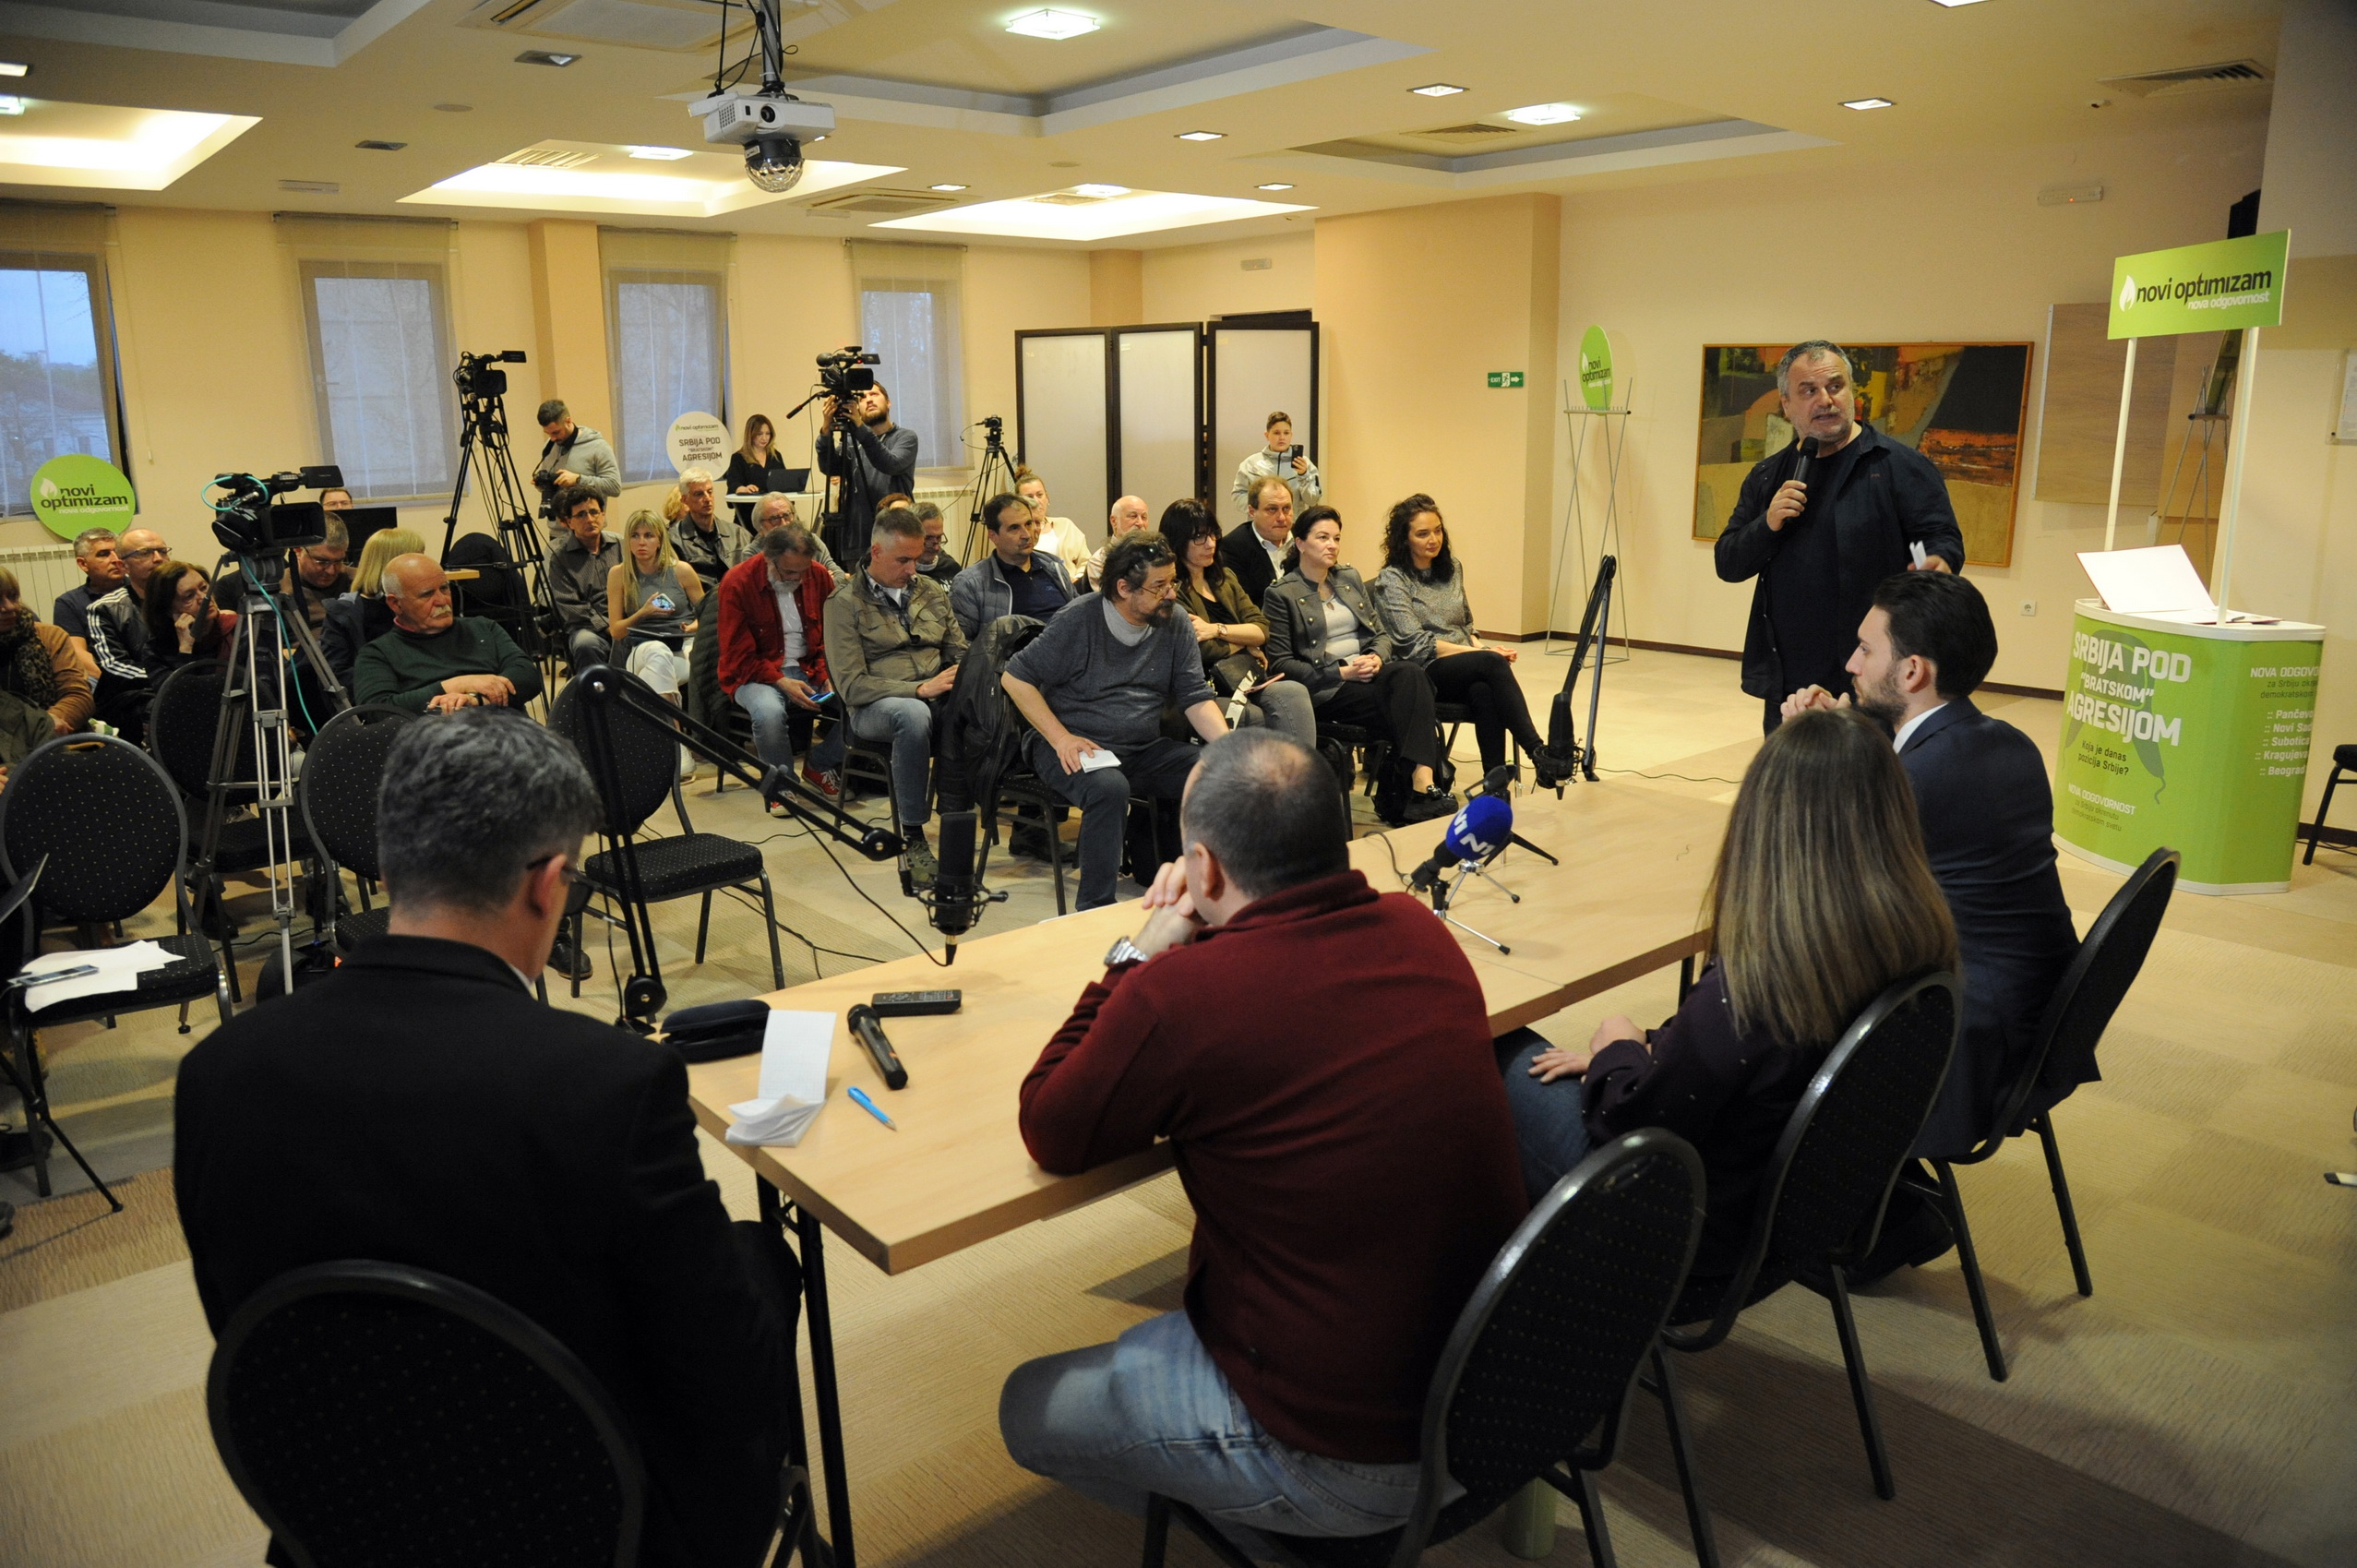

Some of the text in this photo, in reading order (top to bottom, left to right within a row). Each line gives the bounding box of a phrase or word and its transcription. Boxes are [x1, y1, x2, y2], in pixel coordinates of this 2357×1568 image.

[2136, 270, 2272, 305] novi optimizam
[2188, 290, 2270, 310] nova odgovornost
[1587, 355, 1601, 369] novi
[678, 437, 721, 447] SRBIJA POD
[683, 451, 723, 461] AGRESIJOM
[59, 484, 95, 497] novi
[41, 496, 128, 511] optimizam
[2073, 631, 2192, 683] SRBIJA POD
[2250, 667, 2277, 677] NOVA
[2067, 690, 2182, 747] AGRESIJOM
[2273, 723, 2293, 732] Novi
[2081, 739, 2127, 762] Koja je danas
[2078, 753, 2129, 775] pozicija Srbije?
[2267, 765, 2306, 776] Beograd
[2082, 789, 2136, 815] ODGOVORNOST
[1459, 832, 1496, 856] N1
